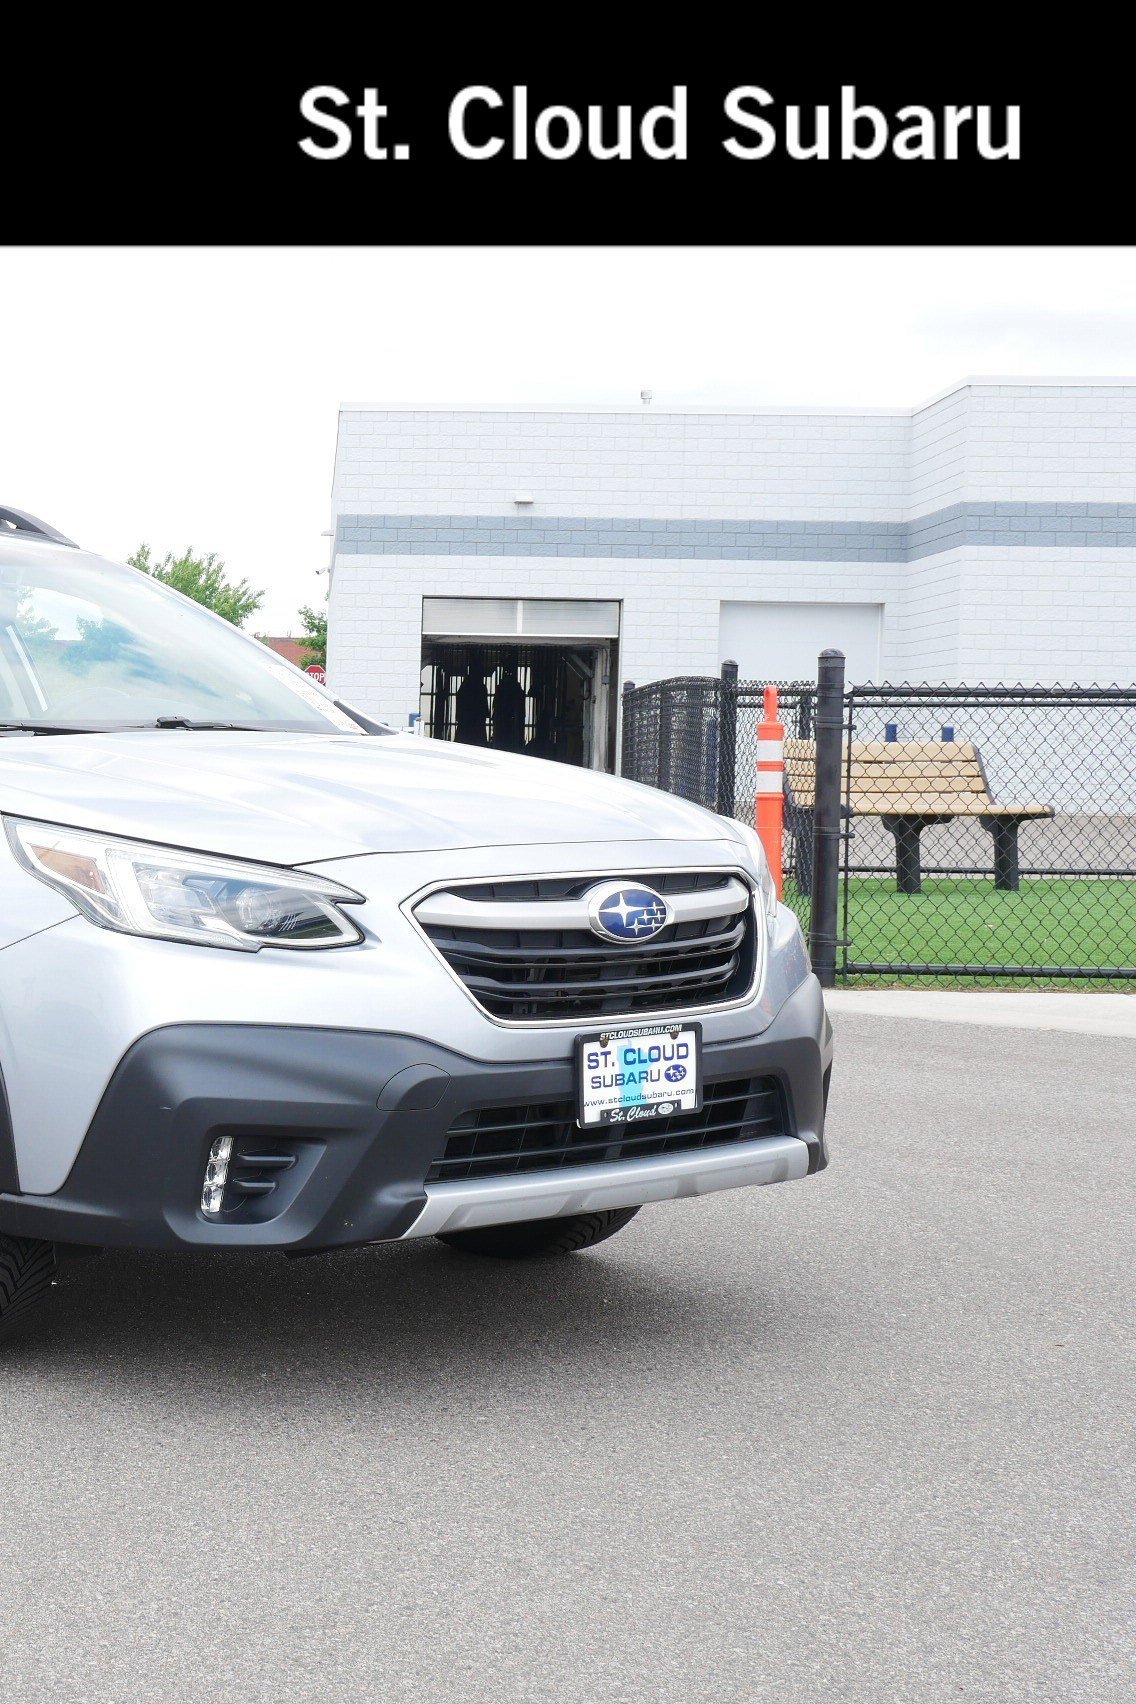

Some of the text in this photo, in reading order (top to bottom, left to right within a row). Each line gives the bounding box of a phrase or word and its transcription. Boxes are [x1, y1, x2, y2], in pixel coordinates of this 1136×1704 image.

[587, 1042, 689, 1070] ST. CLOUD
[590, 1069, 661, 1090] SUBARU
[583, 1087, 695, 1107] www.stcloudsubaru.com
[609, 1105, 657, 1122] St. Cloud
